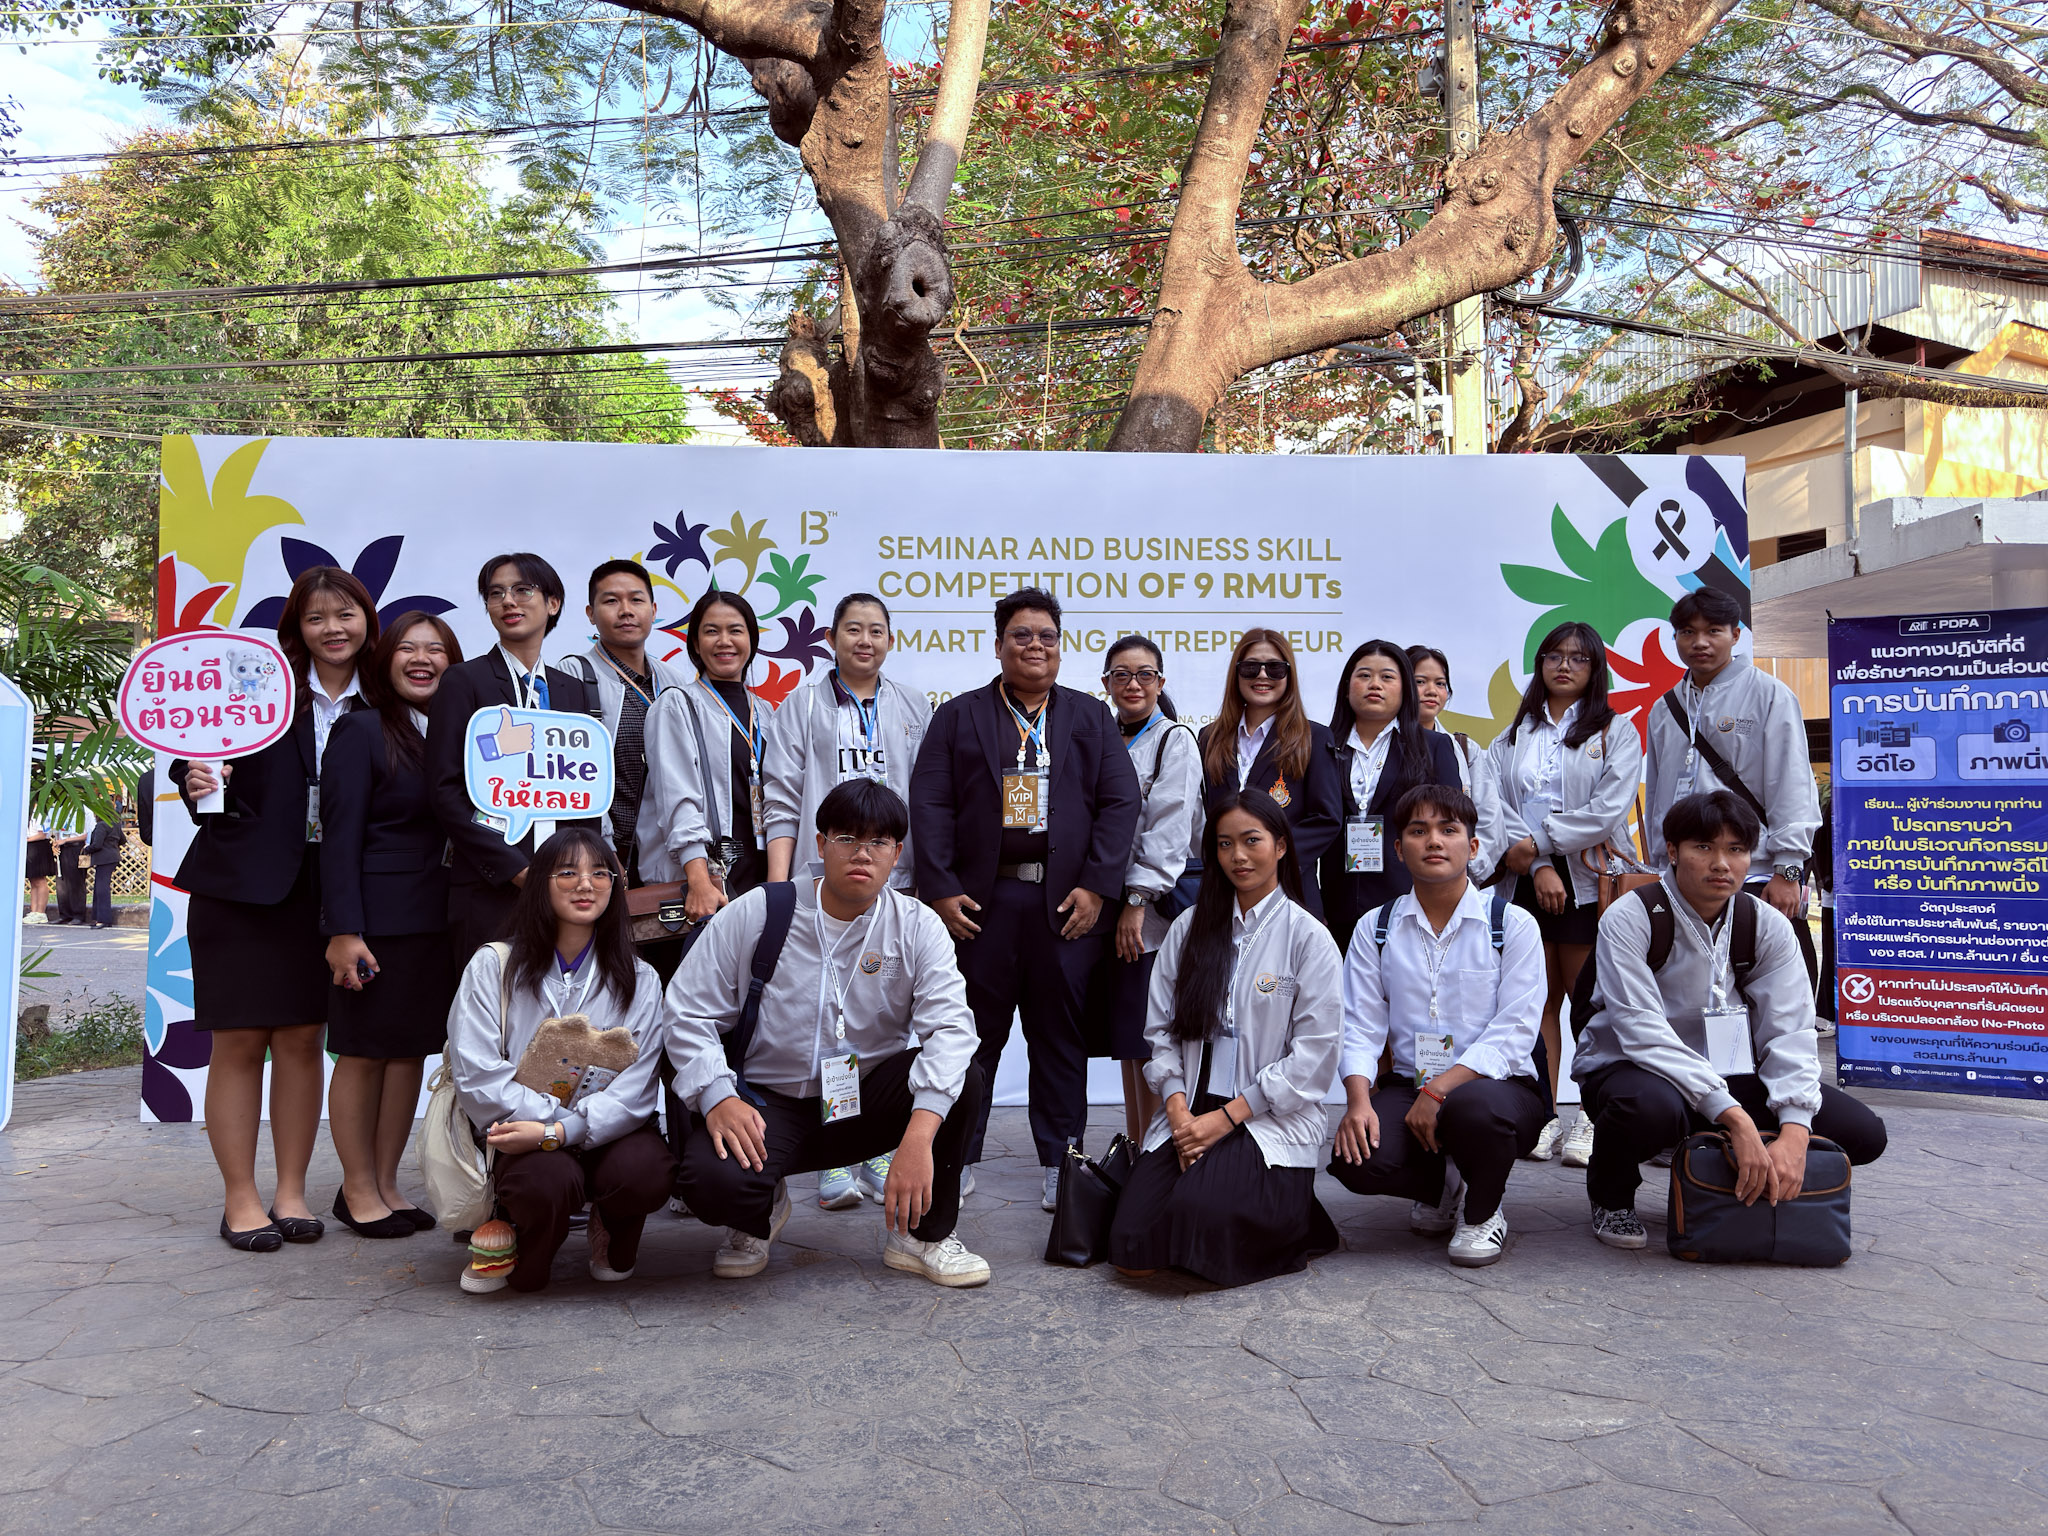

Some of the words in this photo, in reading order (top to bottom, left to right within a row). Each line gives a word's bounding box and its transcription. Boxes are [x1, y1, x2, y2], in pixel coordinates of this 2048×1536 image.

[878, 536, 1019, 560] SEMINAR
[1027, 537, 1095, 560] AND
[1104, 537, 1249, 561] BUSINESS
[1257, 538, 1342, 561] SKILL
[1138, 572, 1185, 599] OF
[1194, 572, 1214, 599] 9
[1224, 573, 1342, 599] RMUTs
[1939, 618, 1980, 629] PDPA
[888, 629, 986, 652] MART
[142, 658, 222, 693] ยินดี
[139, 693, 275, 730] ต้อนรับ
[545, 727, 590, 748] กด
[527, 753, 598, 781] Like
[1857, 753, 1915, 773] วิดีโอ
[488, 777, 591, 809] ให้เลย
[1011, 793, 1030, 802] VIP
[1907, 797, 1991, 812] ผู้เข้าร่วมงาน
[1995, 797, 2042, 812] ทุกท่าน
[1892, 816, 2012, 832] โปรดทราบว่า
[1848, 855, 2048, 873] จะมีการบันทึกภาพวิดีโ
[1874, 874, 1912, 890] หรือ
[1917, 874, 2040, 893] บันทึกภาพนิ่ง
[1920, 902, 1996, 916] วัตถุประสงค์
[2003, 922, 2048, 931] รายงา
[1869, 949, 1894, 958] ของ
[1938, 949, 2009, 962] มทร.ล้านนา
[2020, 949, 2039, 963] อื่น
[1878, 995, 2045, 1014] โปรดแจ้งบุคลากรที่รับผิดชอบ
[1845, 1010, 1869, 1021] หรือ
[1872, 1012, 1979, 1027] บริเวณปลอดกล้อง
[1981, 1018, 2045, 1031] (No-Photo
